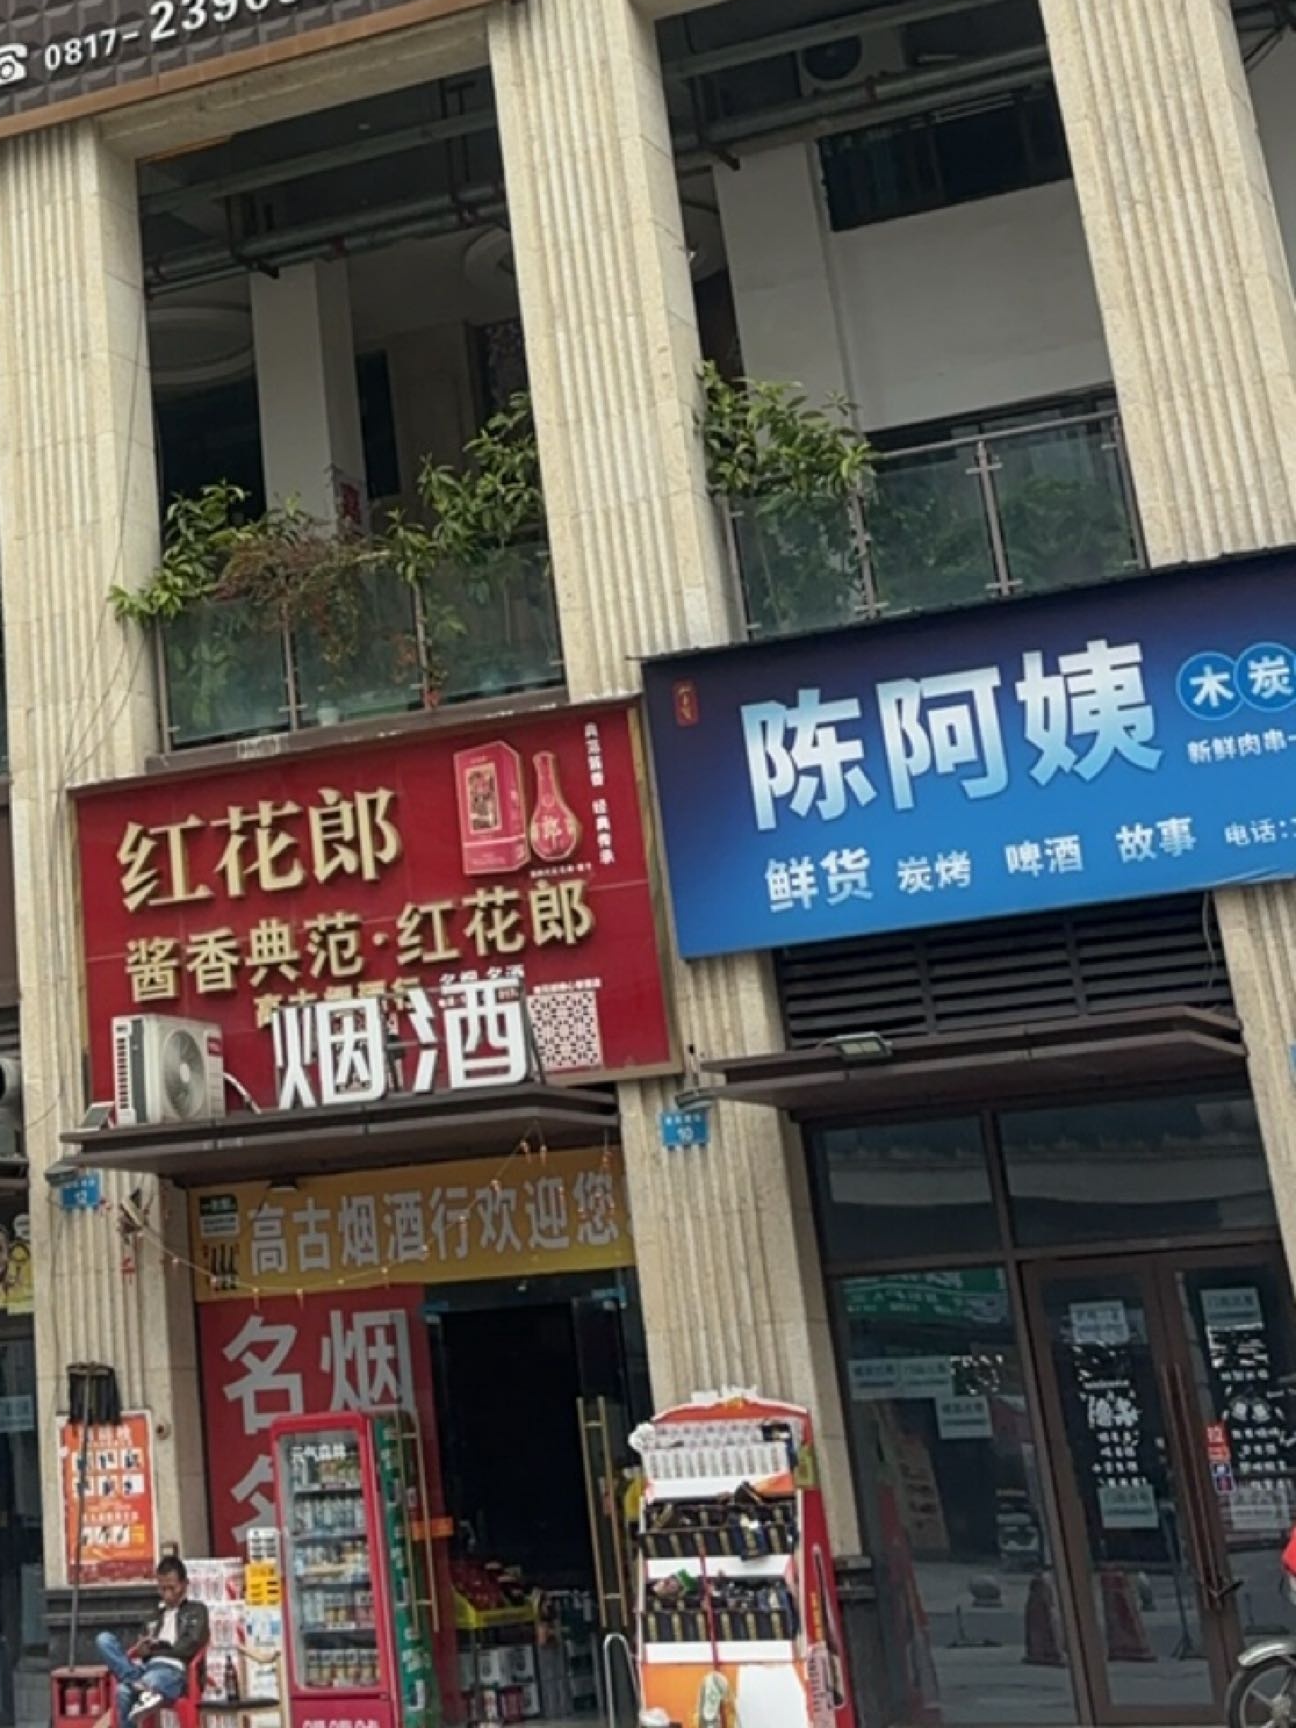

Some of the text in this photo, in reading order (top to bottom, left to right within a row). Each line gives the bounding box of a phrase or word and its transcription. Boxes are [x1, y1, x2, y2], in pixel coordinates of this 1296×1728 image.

[740, 638, 1165, 832] 陈阿姨
[116, 786, 402, 913] 红花郎
[764, 847, 873, 913] 鲜货
[897, 849, 972, 894] 炭烤
[1005, 835, 1083, 877] 啤酒
[1115, 816, 1196, 864] 故事
[125, 877, 596, 1003] 酱香典范·红花郎
[271, 977, 530, 1111] 烟酒
[222, 1308, 416, 1434] 名烟
